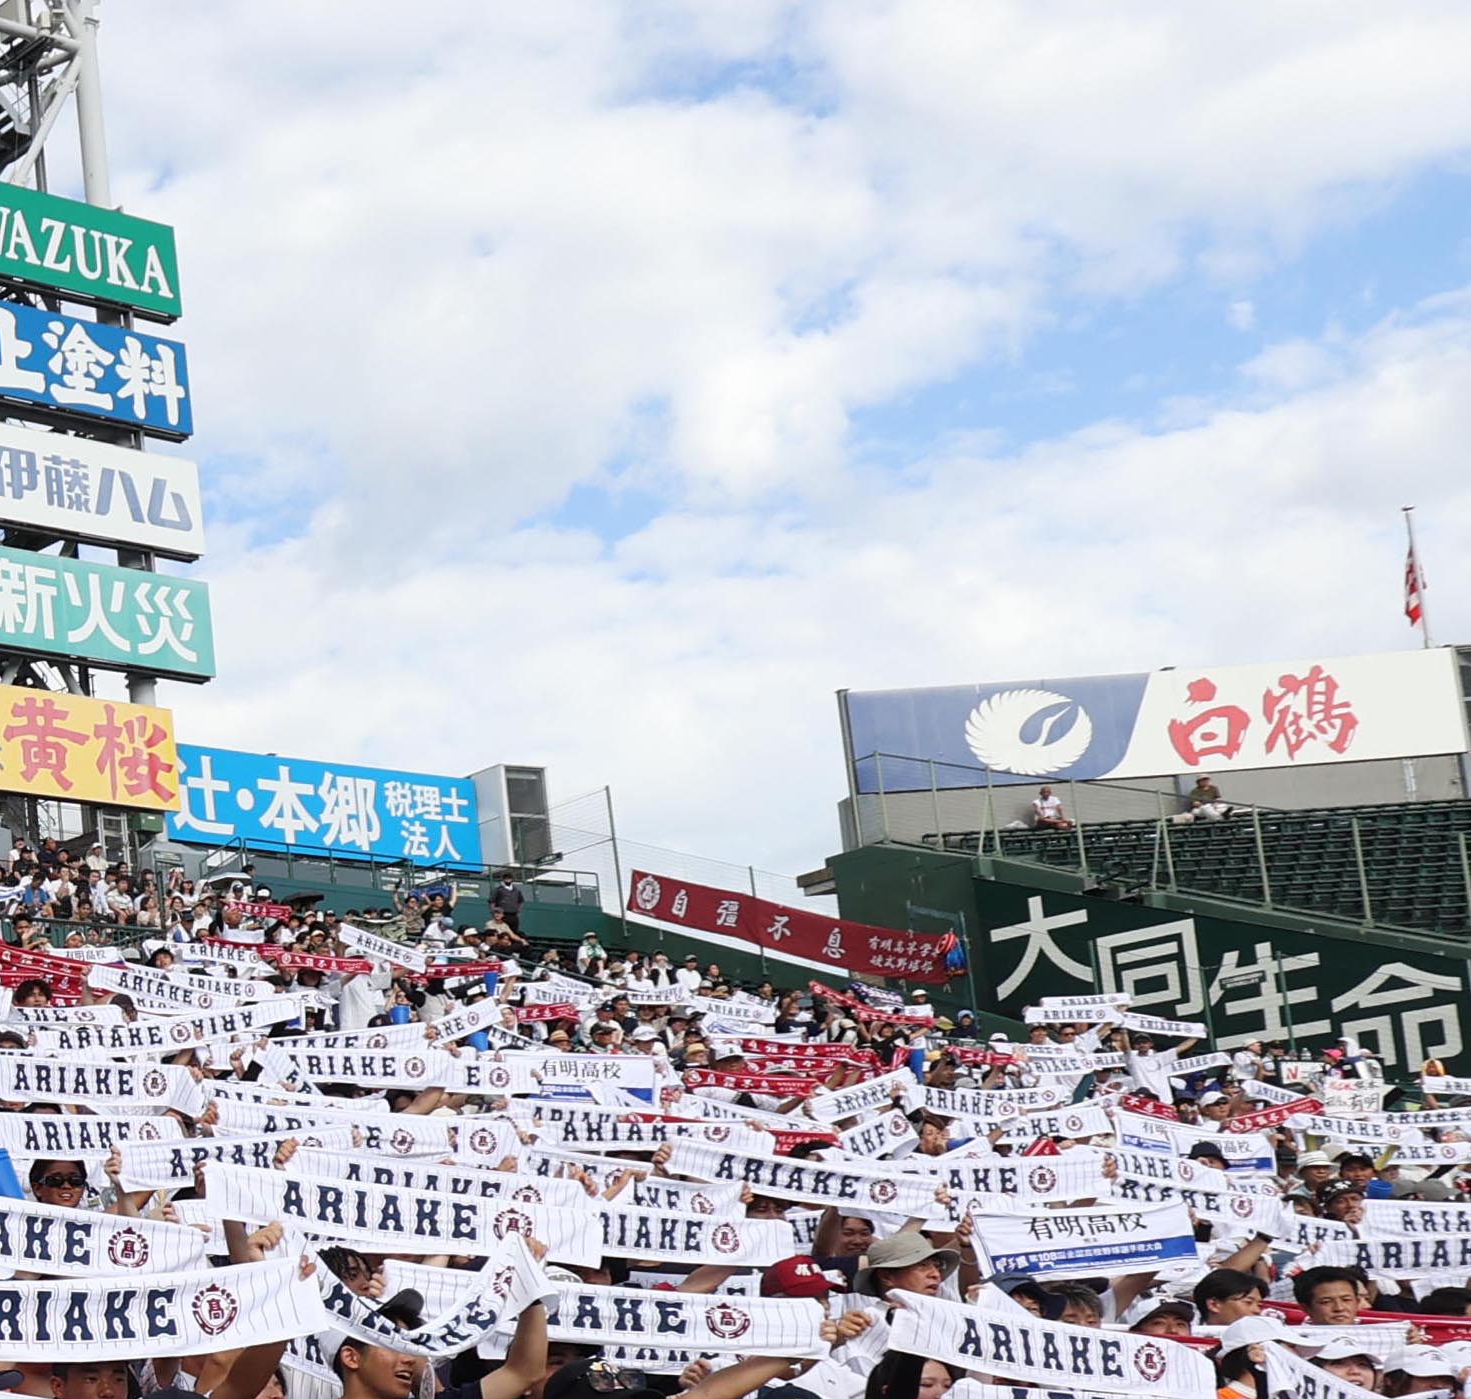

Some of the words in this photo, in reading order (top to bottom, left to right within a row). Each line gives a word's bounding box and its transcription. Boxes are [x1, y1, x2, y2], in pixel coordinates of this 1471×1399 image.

[1166, 666, 1360, 766] 白鶴
[3, 696, 175, 801] 黄桜
[383, 780, 469, 823] 税理士
[400, 820, 461, 860] 法人
[65, 947, 107, 961] 有明高校
[189, 945, 244, 961] ARIAKE
[355, 935, 403, 960] ARIAKE
[868, 936, 938, 957] 有明高等学
[118, 972, 192, 1003] ARIAKE
[187, 979, 243, 996] ARIAKE
[990, 895, 1464, 1072] 大同生命
[1043, 1009, 1092, 1019] ARIAKE
[58, 1025, 159, 1050] ARIAKE
[13, 1062, 135, 1097] ARIAKE
[540, 1058, 622, 1081] 有明高校
[835, 1080, 892, 1114] ARIAKE
[925, 1089, 994, 1116] ARIAKE
[974, 1118, 1058, 1135] ARKE
[1311, 1118, 1383, 1136] ARIAKE
[1387, 1110, 1459, 1124] ARIAKE
[25, 1120, 130, 1150] ARIAKE
[170, 1137, 283, 1176] ARAK
[715, 1154, 858, 1198] ARIAKE
[283, 1181, 478, 1240] ARIAKE
[1024, 1213, 1147, 1241] 有明高校
[959, 1317, 1123, 1377] ARIAKE
